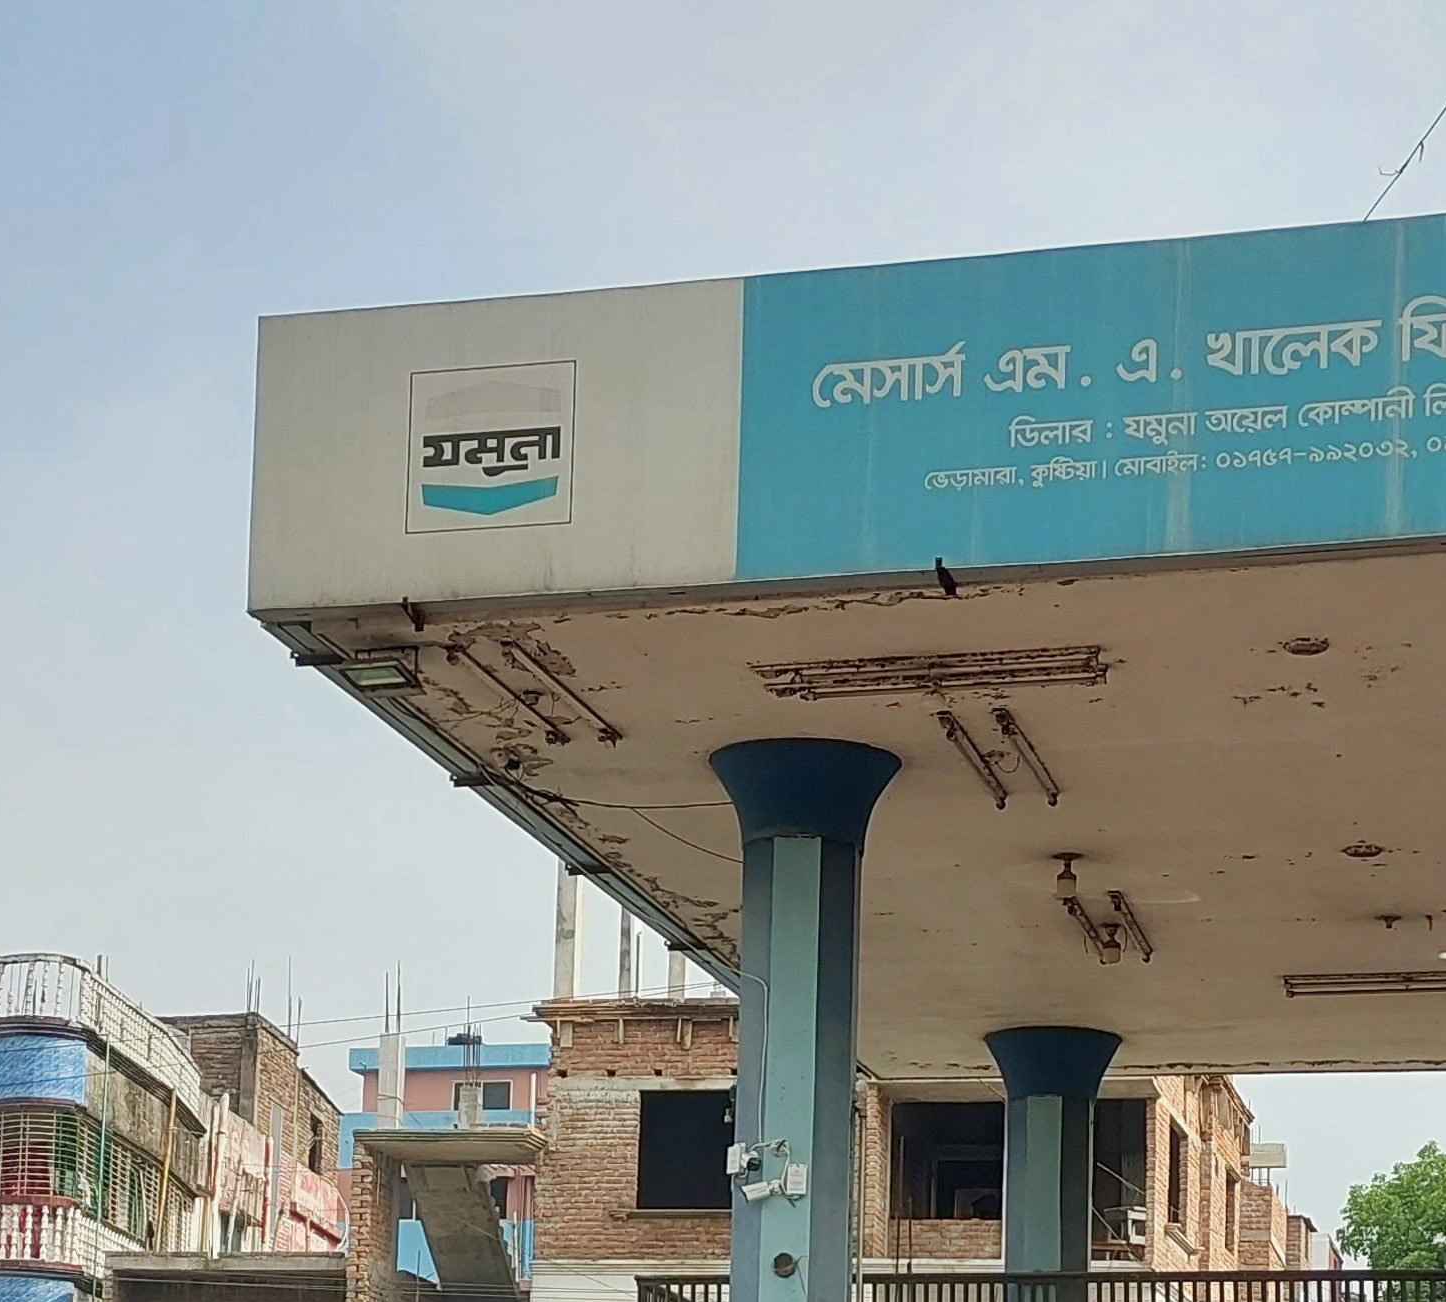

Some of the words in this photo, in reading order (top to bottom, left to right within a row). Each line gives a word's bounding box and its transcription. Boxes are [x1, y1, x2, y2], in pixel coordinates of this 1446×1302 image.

[812, 340, 966, 408] মেসার্স
[1206, 319, 1382, 377] খালেক
[1008, 415, 1094, 448] ডিলার
[1122, 411, 1198, 446] যমুনা
[1205, 405, 1288, 434] অয়েল
[1297, 385, 1415, 429] কোম্পানী
[422, 425, 562, 478] যমুনা
